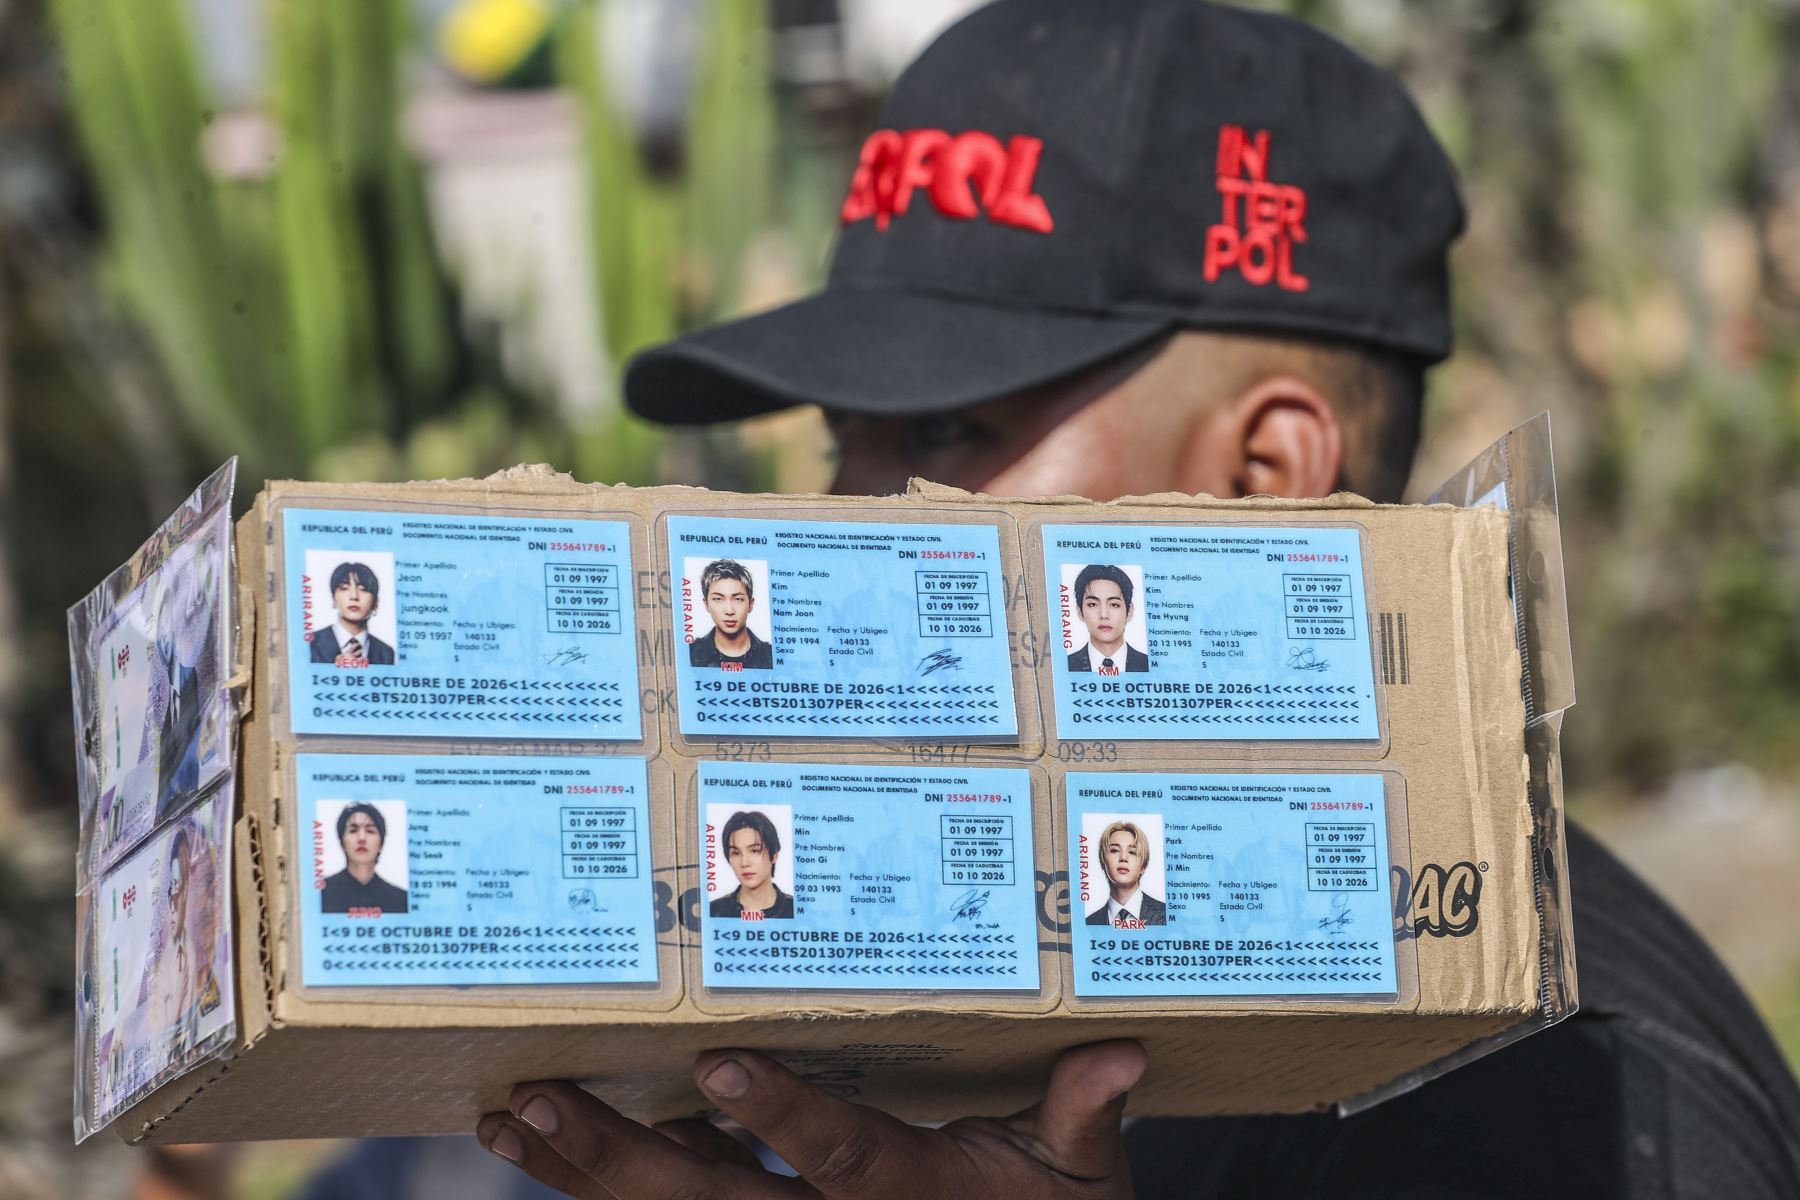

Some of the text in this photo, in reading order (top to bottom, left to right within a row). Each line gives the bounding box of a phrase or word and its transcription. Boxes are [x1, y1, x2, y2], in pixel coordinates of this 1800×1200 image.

[1214, 123, 1271, 181] IN
[1214, 177, 1307, 243] TER
[1203, 224, 1309, 292] POL
[302, 524, 349, 534] REPUBLICA
[352, 526, 367, 534] DEL
[680, 535, 767, 544] REPUBLICA DEL PERÚ
[529, 542, 615, 552] DNI 255641789-1
[1121, 541, 1141, 549] PERÚ
[899, 551, 985, 560] DNI 255641789-1
[1267, 554, 1348, 562] DNI 255641789-1
[395, 561, 457, 570] Primer Apellido
[398, 574, 422, 583] Jeon
[771, 569, 829, 579] Primer Apellido
[1171, 574, 1201, 582] Apellido
[301, 575, 314, 643] ARIRANG
[682, 577, 694, 644] ARIRANG
[1060, 584, 1072, 649] ARIRANG
[1164, 613, 1188, 621] Hyung
[721, 661, 743, 672] KIM
[1098, 666, 1119, 677] KIM
[346, 676, 364, 686] DE
[370, 677, 440, 688] OCTUBRE
[446, 678, 465, 688] DE
[728, 682, 746, 692] DE
[751, 682, 819, 693] OCTUBRE
[824, 684, 843, 694] DE
[1102, 683, 1120, 692] DE
[1125, 683, 1190, 693] OCTUBRE
[1195, 684, 1213, 693] DE
[716, 742, 771, 761] 5273
[1058, 742, 1117, 763] 09:33
[313, 774, 360, 782] REPUBLICA
[704, 779, 749, 787] REPUBLICA
[771, 779, 792, 788] PERÚ
[544, 786, 634, 794] DNI 255641789-1
[1079, 789, 1162, 798] REPUBLICA DEL PERÚ
[925, 794, 1011, 803] DNI 255641789-1
[1290, 802, 1373, 811] DNI 255641789-1
[795, 814, 854, 823] Primer Apellido
[409, 824, 428, 832] Jung
[1191, 824, 1222, 832] Apellido
[795, 843, 845, 852] Pre Nombres
[313, 820, 326, 889] ARIRANG
[705, 824, 716, 893] ARIRANG
[1079, 834, 1089, 902] ARIRANG
[1167, 864, 1173, 872] Ji
[1250, 881, 1277, 889] Ubigeo
[741, 911, 763, 921] MIN
[1114, 919, 1146, 931] PARK
[356, 927, 375, 937] DE
[381, 927, 452, 937] OCTUBRE
[459, 927, 477, 937] DE
[746, 931, 765, 941] DE
[770, 931, 838, 942] OCTUBRE
[845, 932, 863, 942] DE
[1122, 940, 1139, 950] DE
[1144, 940, 1210, 950] OCTUBRE
[1215, 941, 1233, 950] DE
